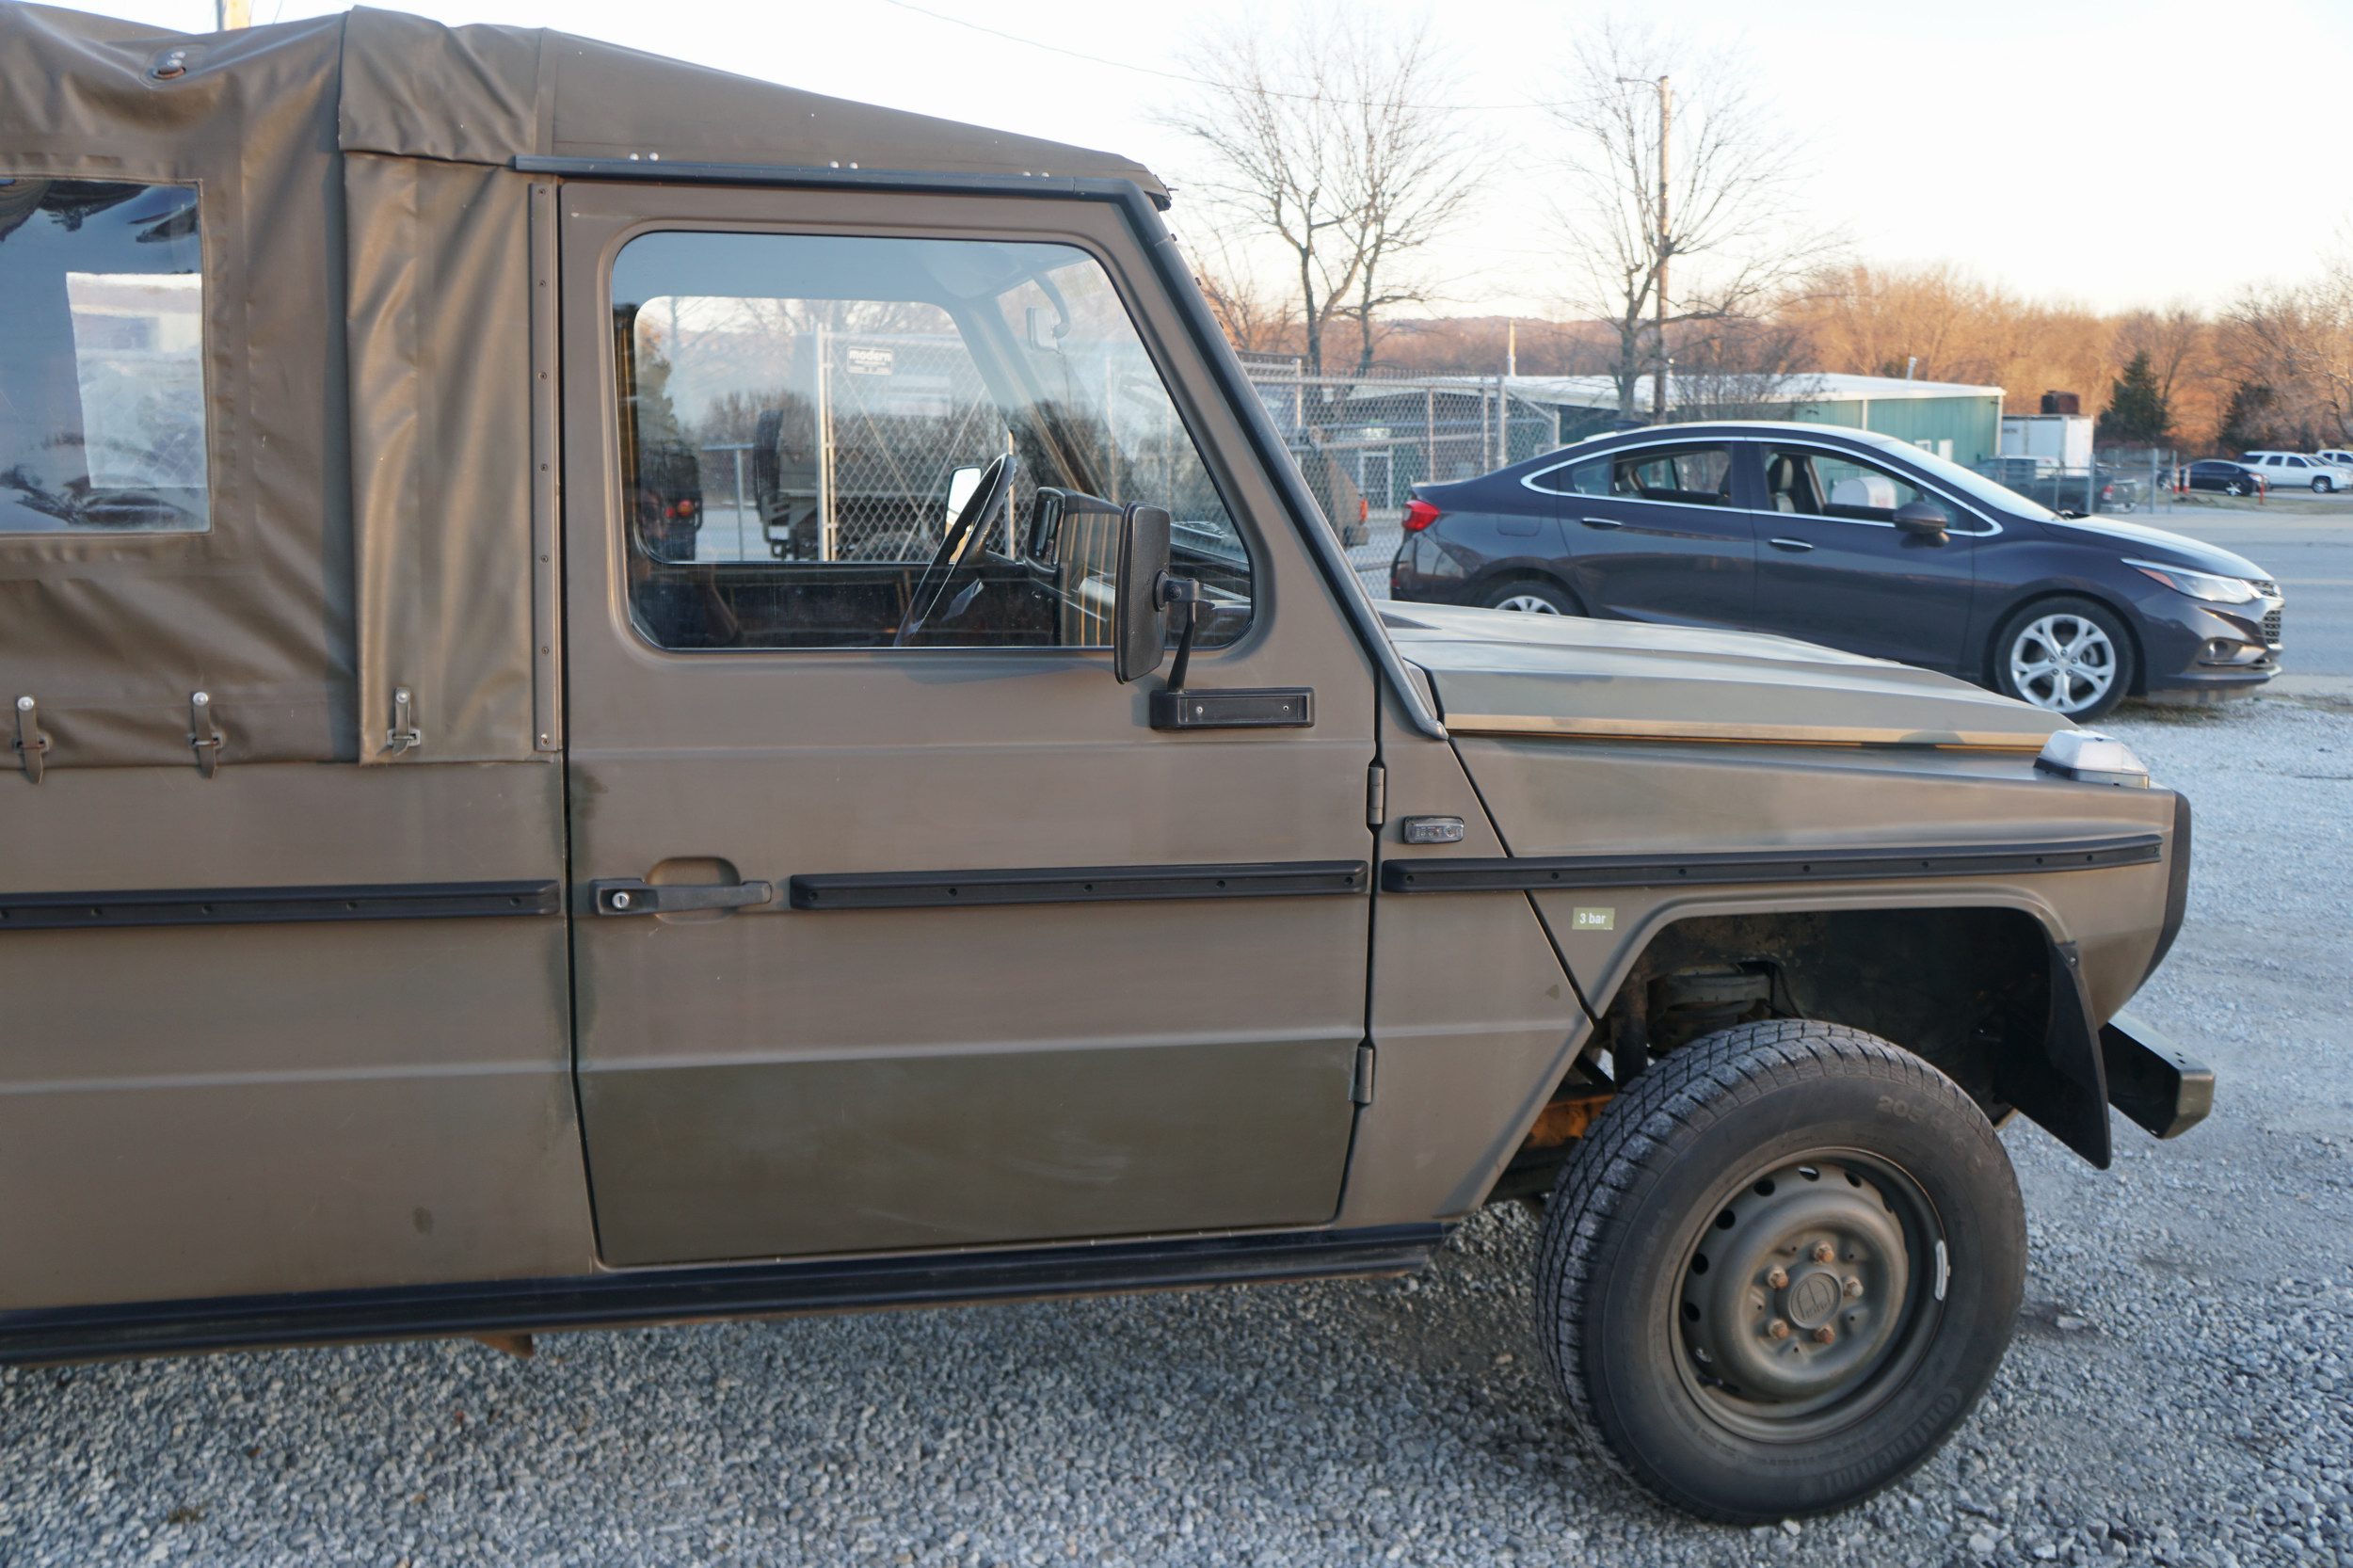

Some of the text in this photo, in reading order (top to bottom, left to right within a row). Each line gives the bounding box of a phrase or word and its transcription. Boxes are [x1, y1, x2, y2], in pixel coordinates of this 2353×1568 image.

[849, 348, 892, 361] modern
[1579, 912, 1606, 924] 3 bar
[1876, 1095, 1925, 1123] 205
[1825, 1386, 1963, 1496] Continental
